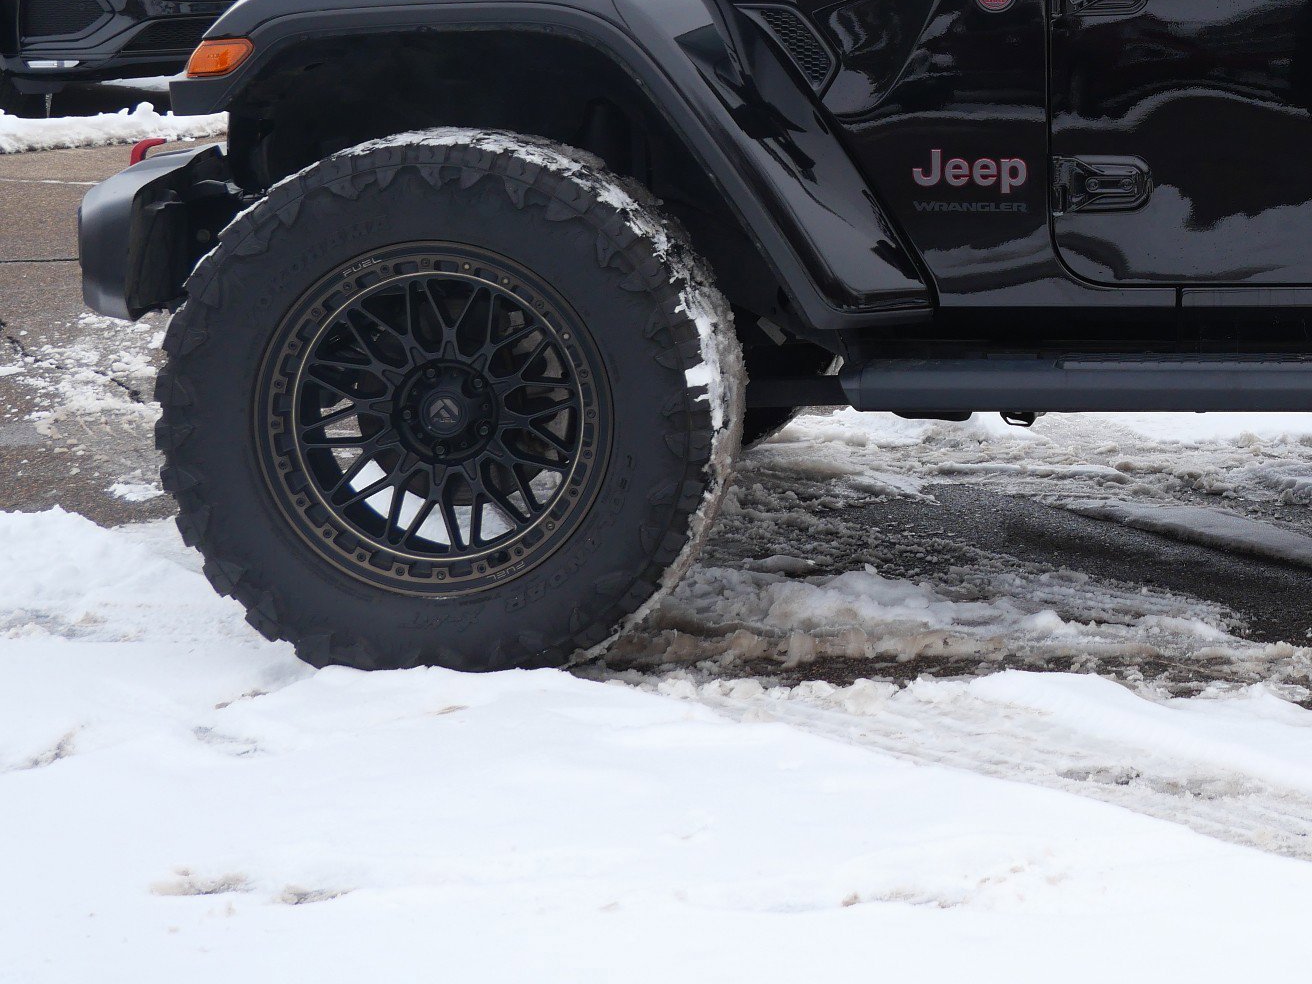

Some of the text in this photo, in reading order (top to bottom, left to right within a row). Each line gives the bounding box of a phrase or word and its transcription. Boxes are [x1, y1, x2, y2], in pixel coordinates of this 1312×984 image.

[912, 148, 1027, 194] Jeep
[913, 200, 1028, 212] WRANGLER
[342, 257, 382, 277] FUEL
[486, 560, 525, 580] FUEL
